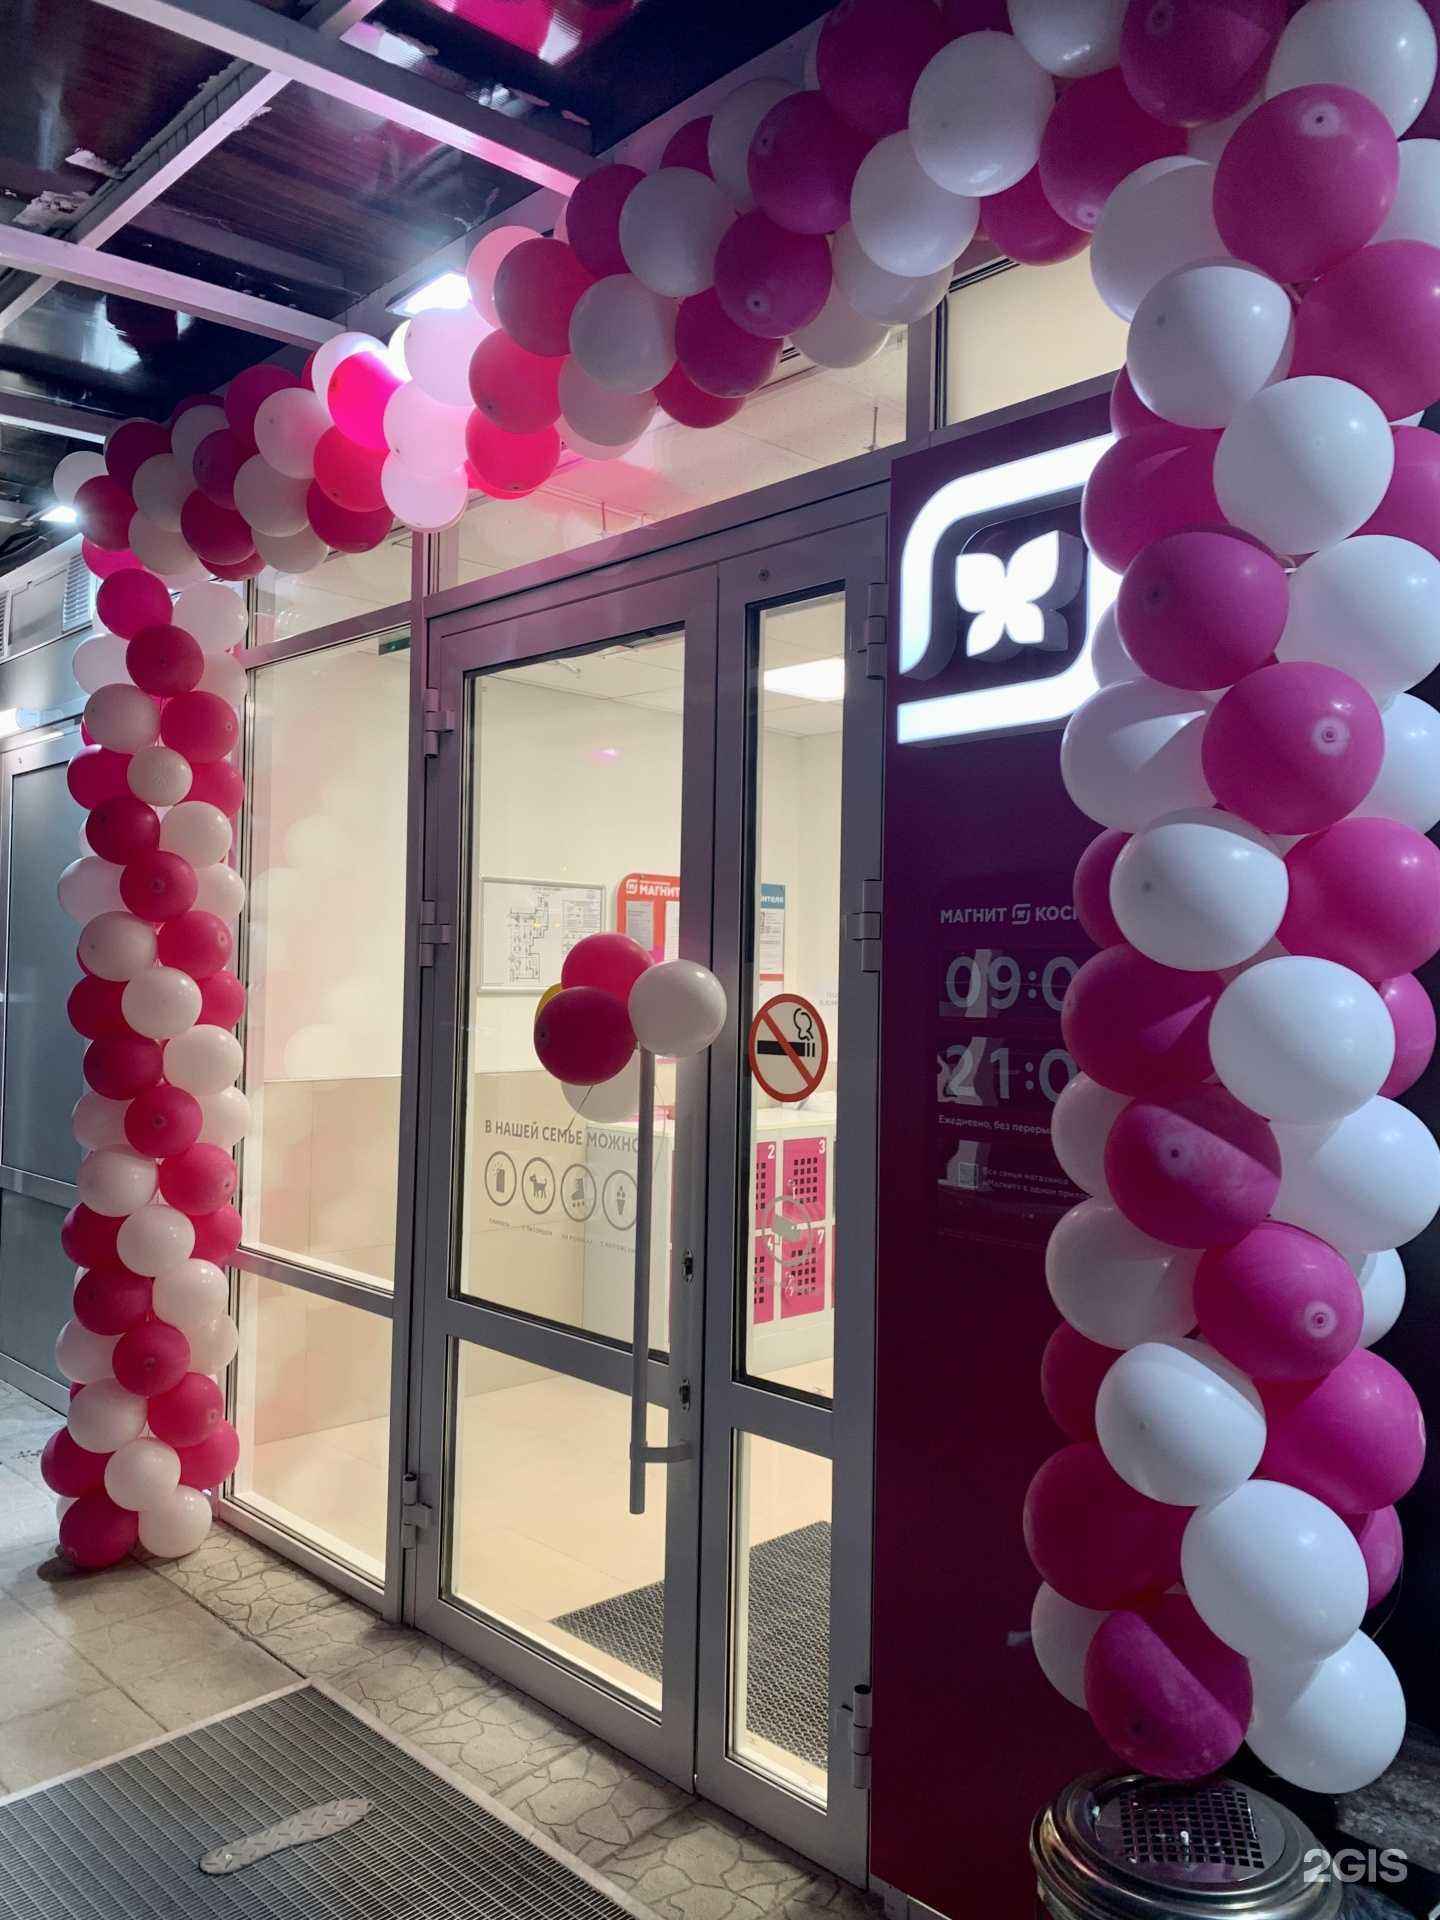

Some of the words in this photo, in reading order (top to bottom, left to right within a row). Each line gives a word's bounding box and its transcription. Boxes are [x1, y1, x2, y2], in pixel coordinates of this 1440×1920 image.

[940, 907, 1007, 924] МАГНИТ
[485, 1119, 492, 1134] В
[495, 1121, 539, 1140] НАШЕЙ
[542, 1126, 582, 1146] СЕМЬЕ
[938, 1114, 992, 1130] Ежедневно,
[994, 1119, 1010, 1131] без
[1012, 1123, 1053, 1136] переры
[768, 1144, 776, 1159] 2
[818, 1138, 826, 1154] 3
